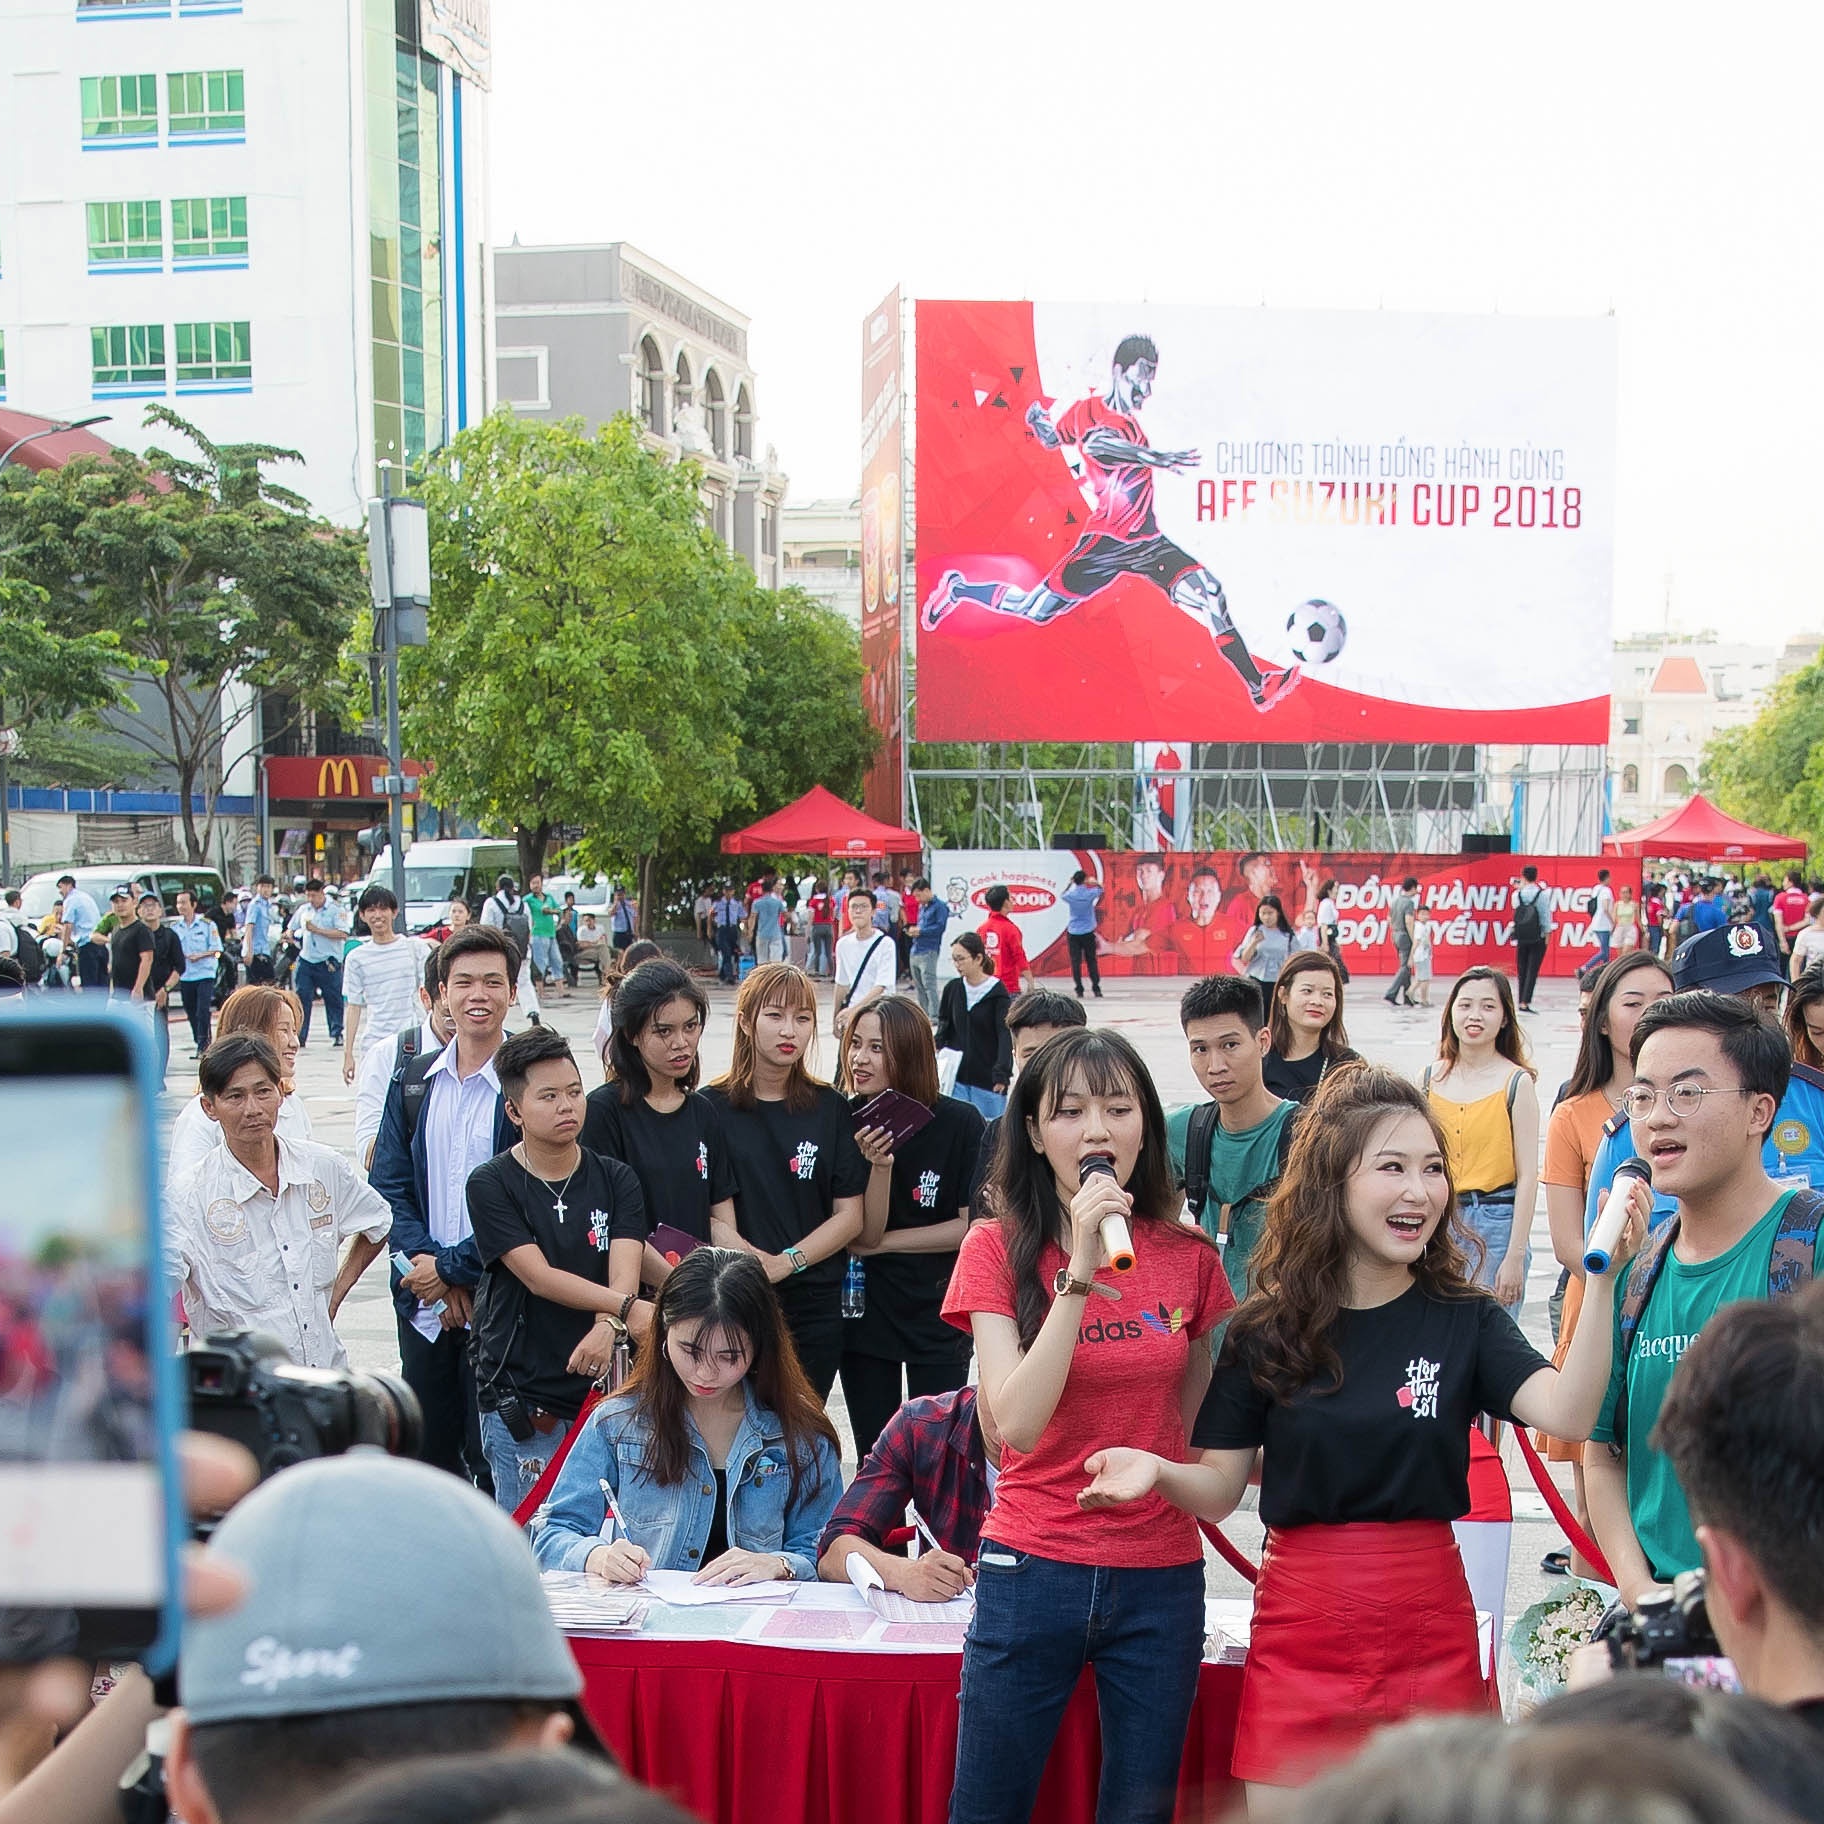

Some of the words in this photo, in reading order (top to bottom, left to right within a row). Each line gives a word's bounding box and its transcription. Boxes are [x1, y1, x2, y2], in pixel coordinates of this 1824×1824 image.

[1197, 479, 1258, 522] AFF
[1269, 480, 1397, 525] SUZUKI
[1412, 484, 1480, 527] CUP
[1493, 486, 1581, 529] 2018
[970, 872, 997, 888] Cook
[1002, 871, 1057, 888] happiness
[1336, 874, 1422, 910] ĐỒN
[1426, 879, 1508, 911] HÀNH
[1336, 913, 1389, 951] ĐỘI
[1559, 922, 1618, 947] NA
[1076, 1318, 1143, 1345] idas
